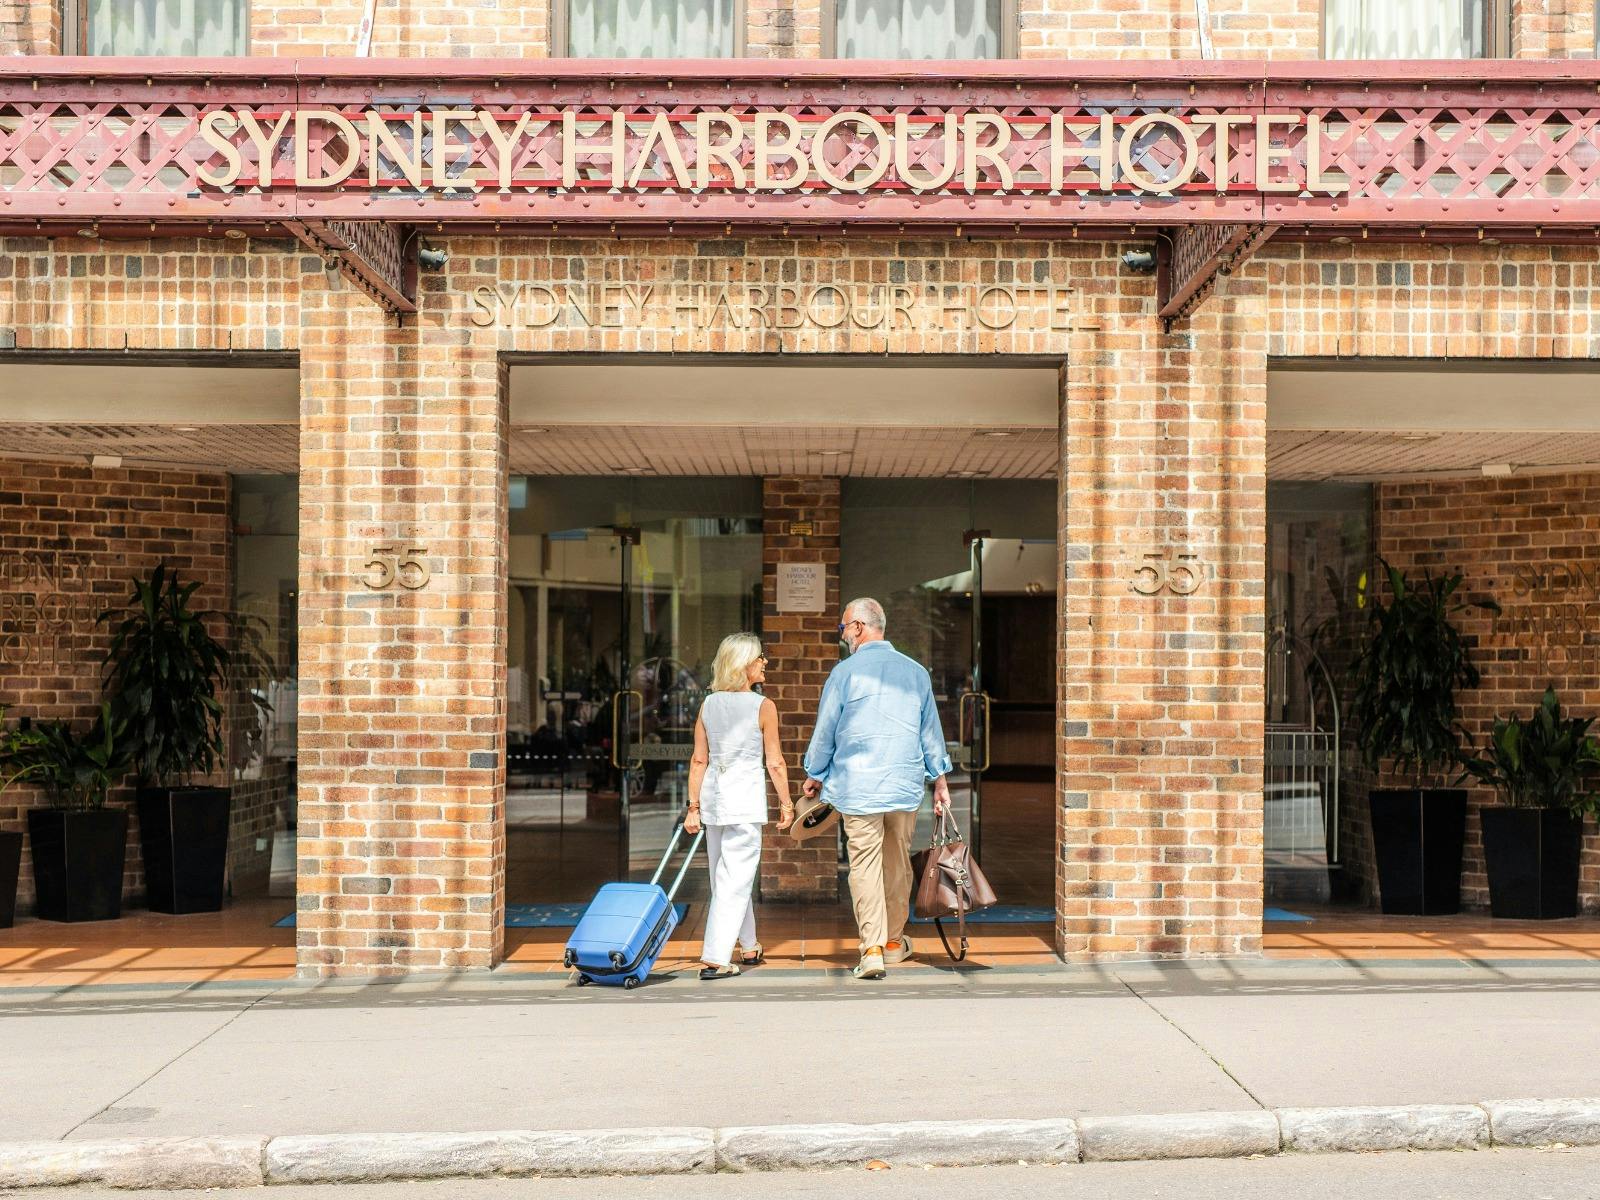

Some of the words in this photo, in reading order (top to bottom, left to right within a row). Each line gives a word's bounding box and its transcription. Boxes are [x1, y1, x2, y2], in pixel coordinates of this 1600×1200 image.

[195, 110, 531, 187] SYDNEY
[562, 111, 1014, 190] HARBOUR
[1050, 113, 1350, 193] HOTEL
[471, 283, 654, 328] SYDNEY
[671, 284, 916, 329] HARBOUR
[939, 286, 1100, 332] HOTEL
[0, 554, 92, 592] DNEY
[363, 544, 430, 590] 55
[1133, 546, 1201, 596] 55
